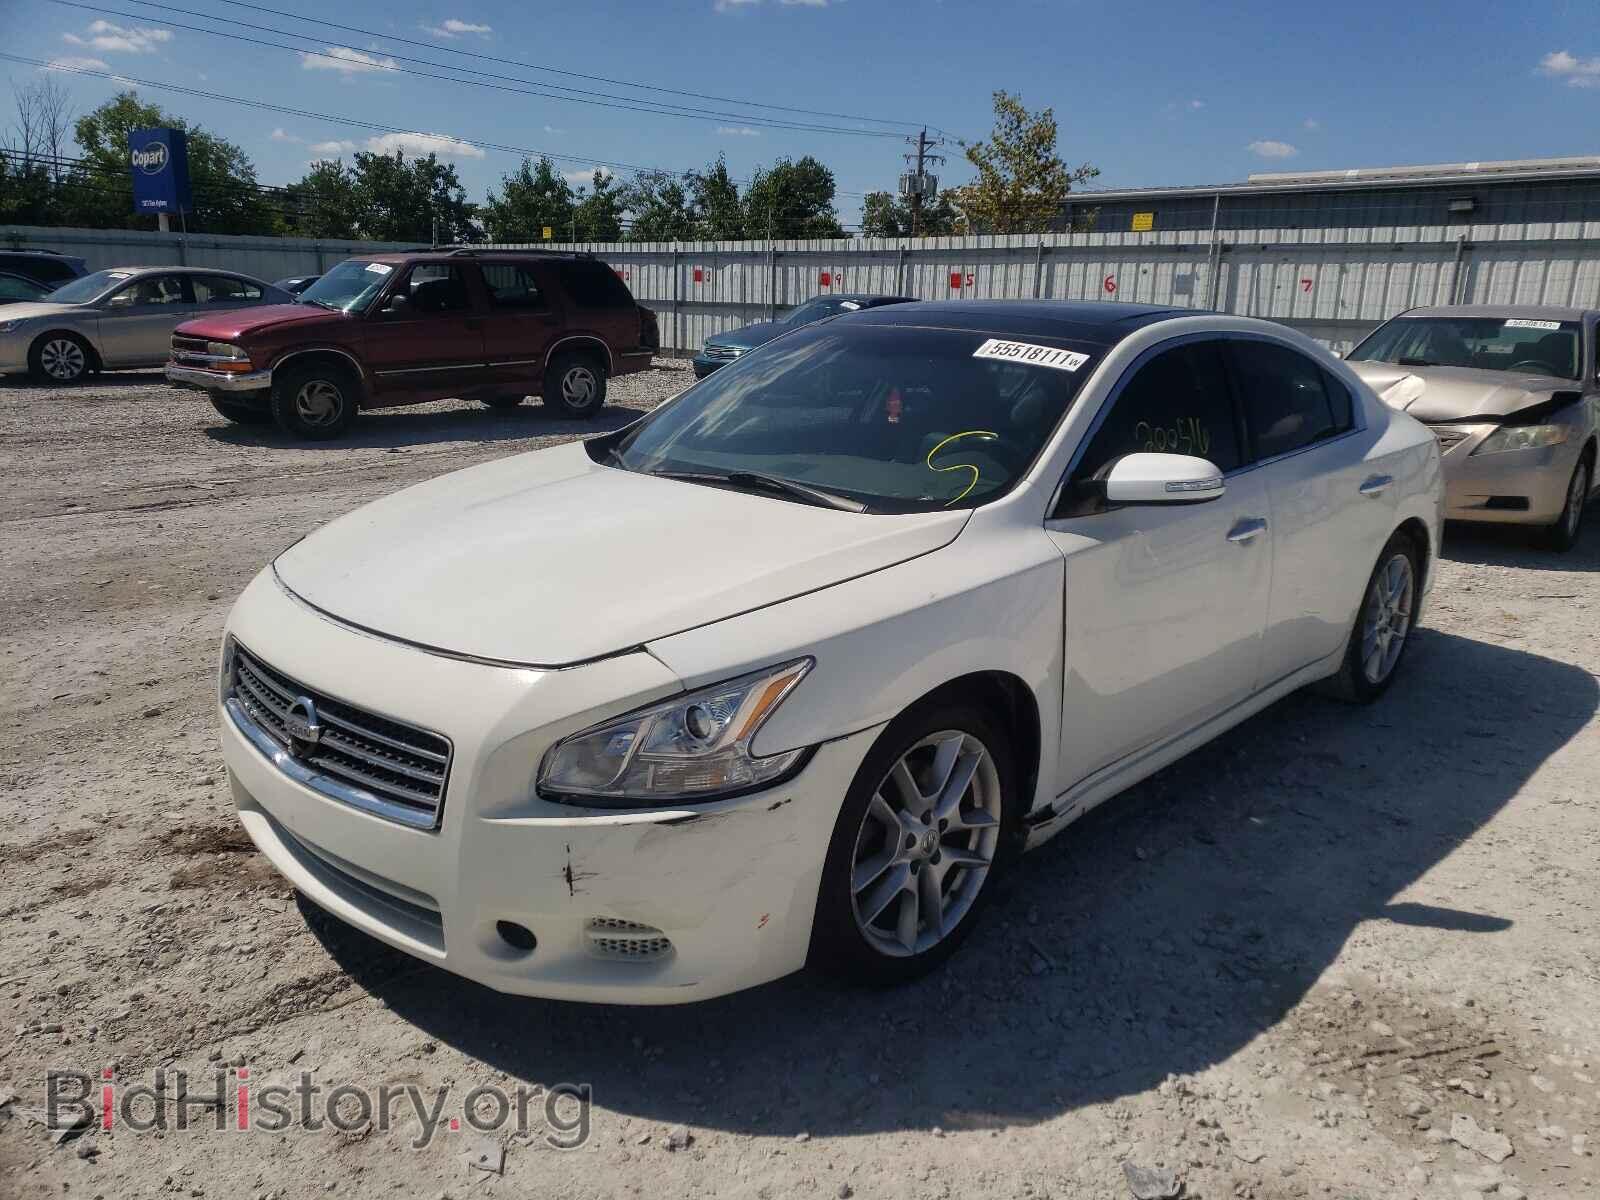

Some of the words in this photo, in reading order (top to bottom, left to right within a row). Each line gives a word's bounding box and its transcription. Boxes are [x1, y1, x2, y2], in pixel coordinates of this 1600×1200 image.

[132, 147, 164, 167] Copart
[965, 273, 975, 287] 5
[1103, 274, 1117, 293] 6
[1301, 279, 1314, 293] 7
